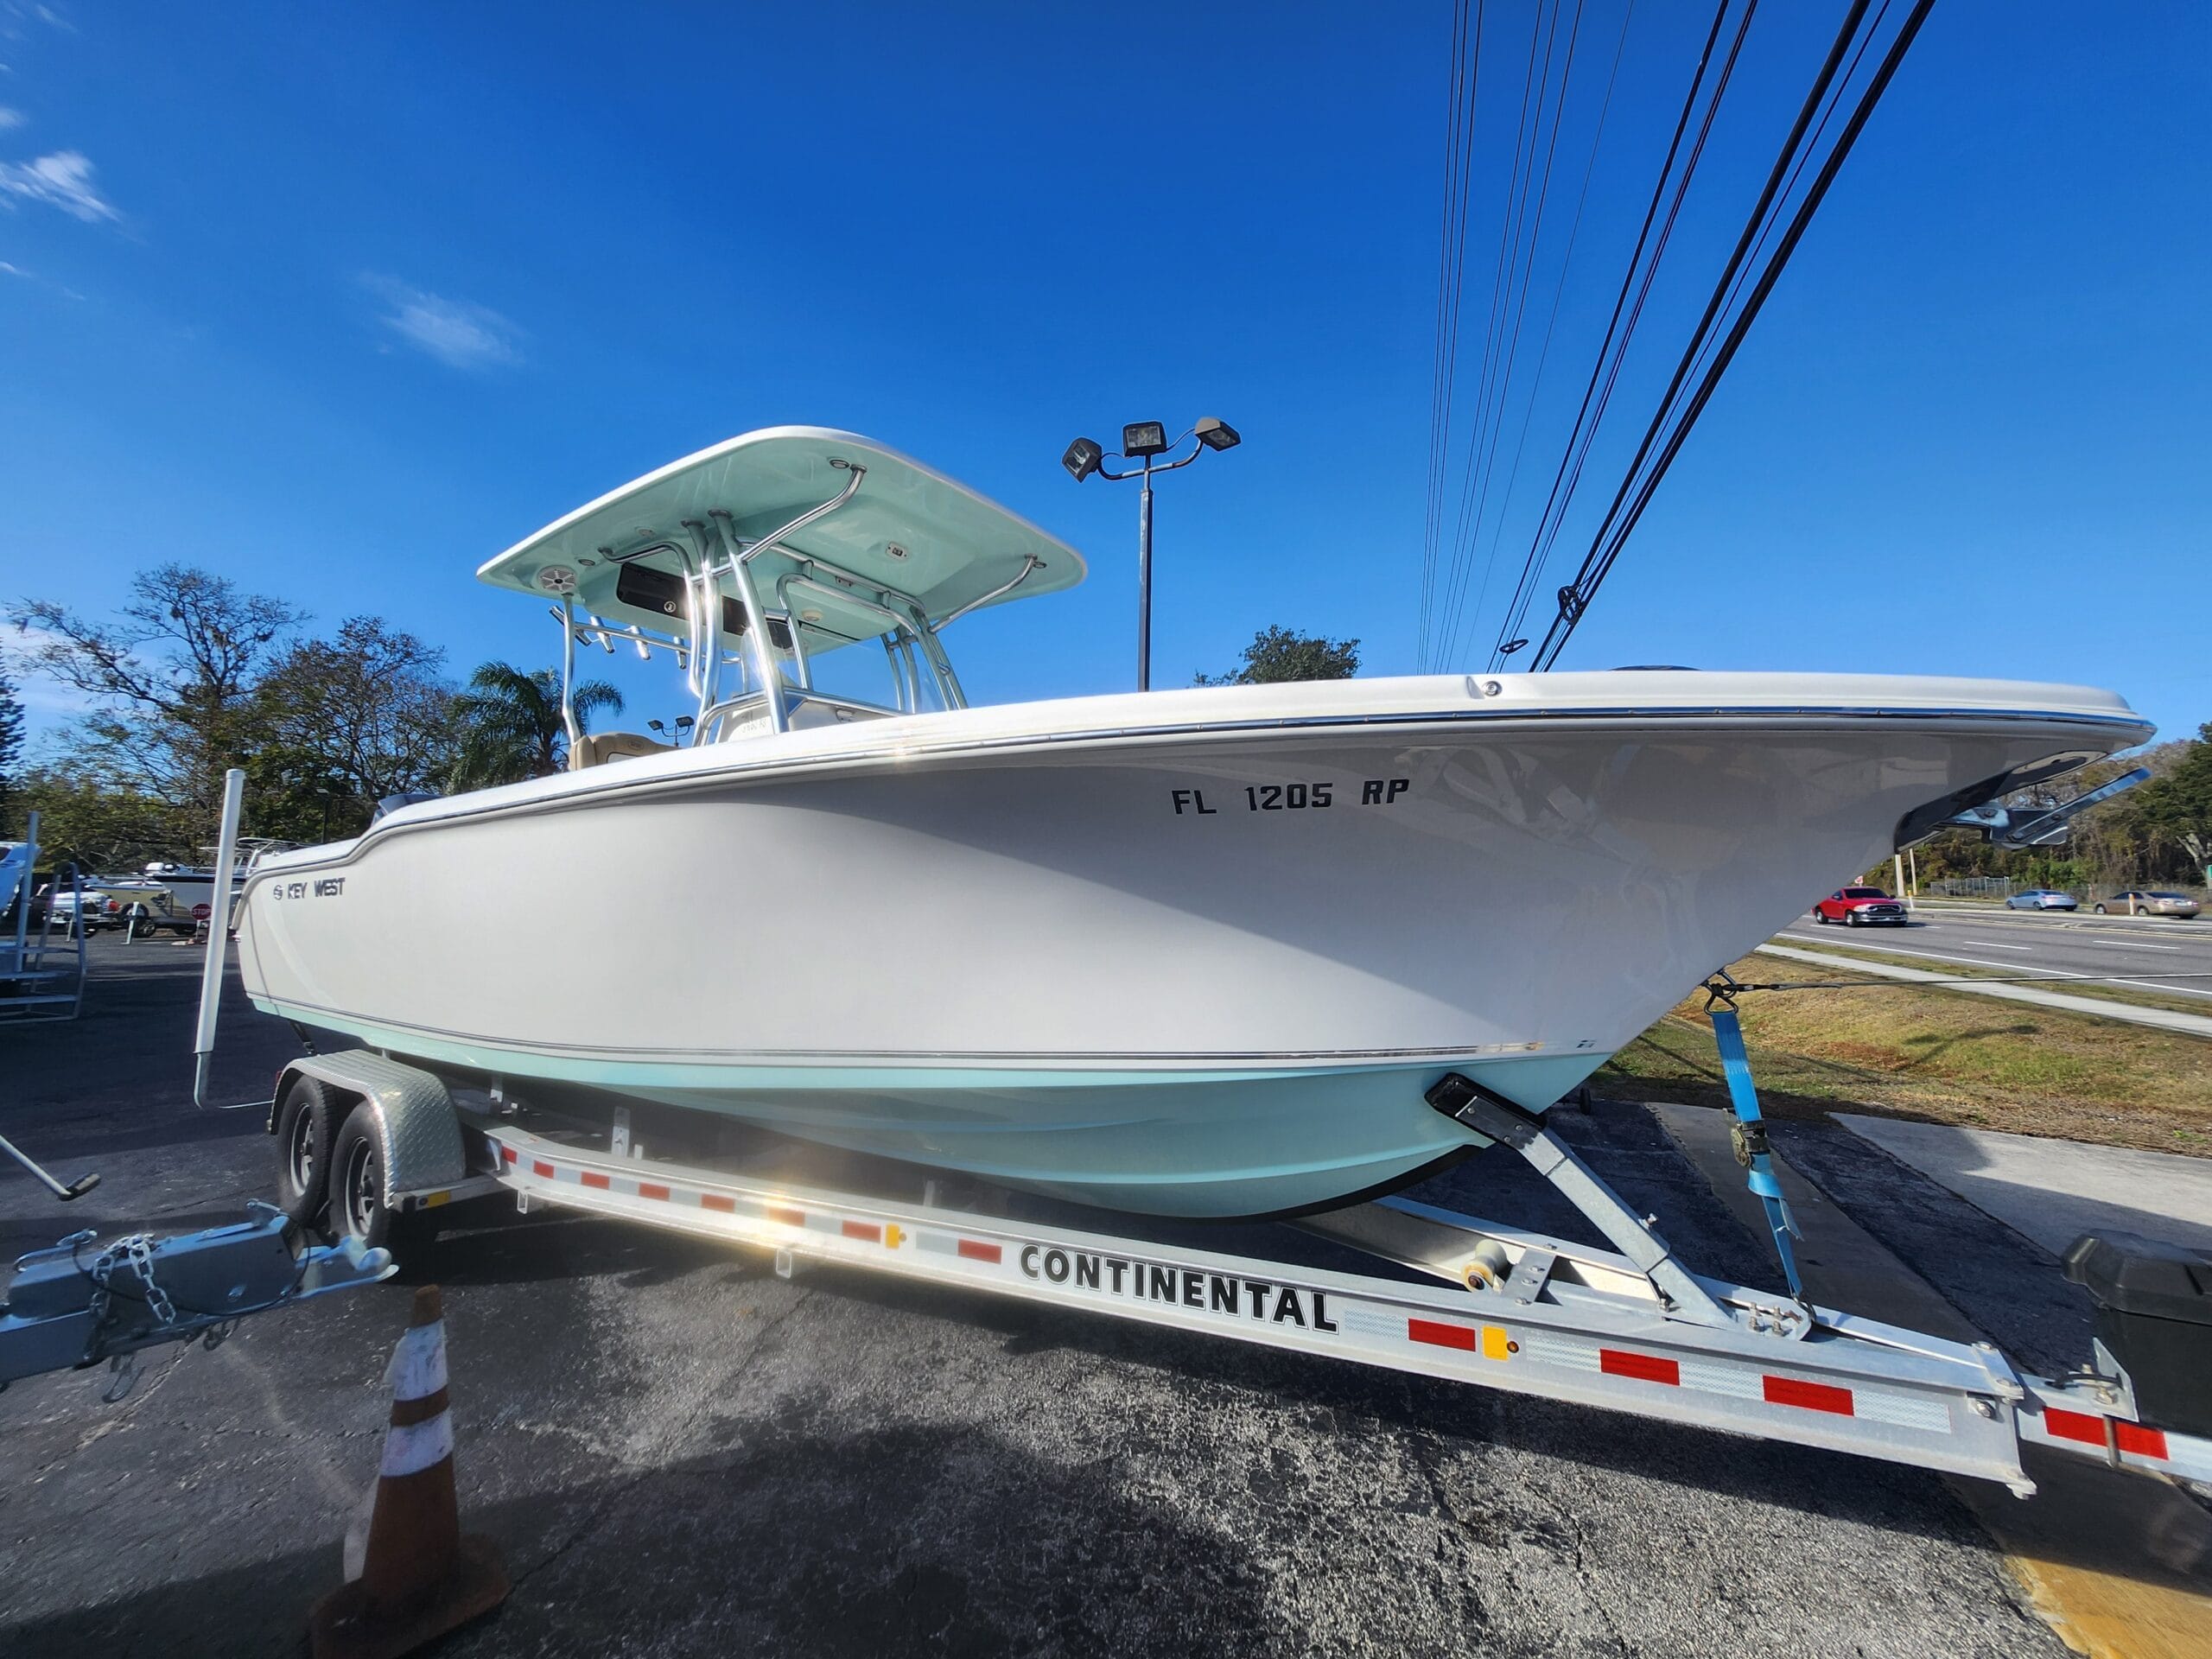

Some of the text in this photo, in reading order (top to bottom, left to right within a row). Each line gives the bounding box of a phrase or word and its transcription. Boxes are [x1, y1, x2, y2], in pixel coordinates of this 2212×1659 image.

[1172, 779, 1409, 815] FL 1205 RP
[288, 877, 346, 899] KEY WEST
[1019, 1243, 1339, 1335] CONTINENTAL
